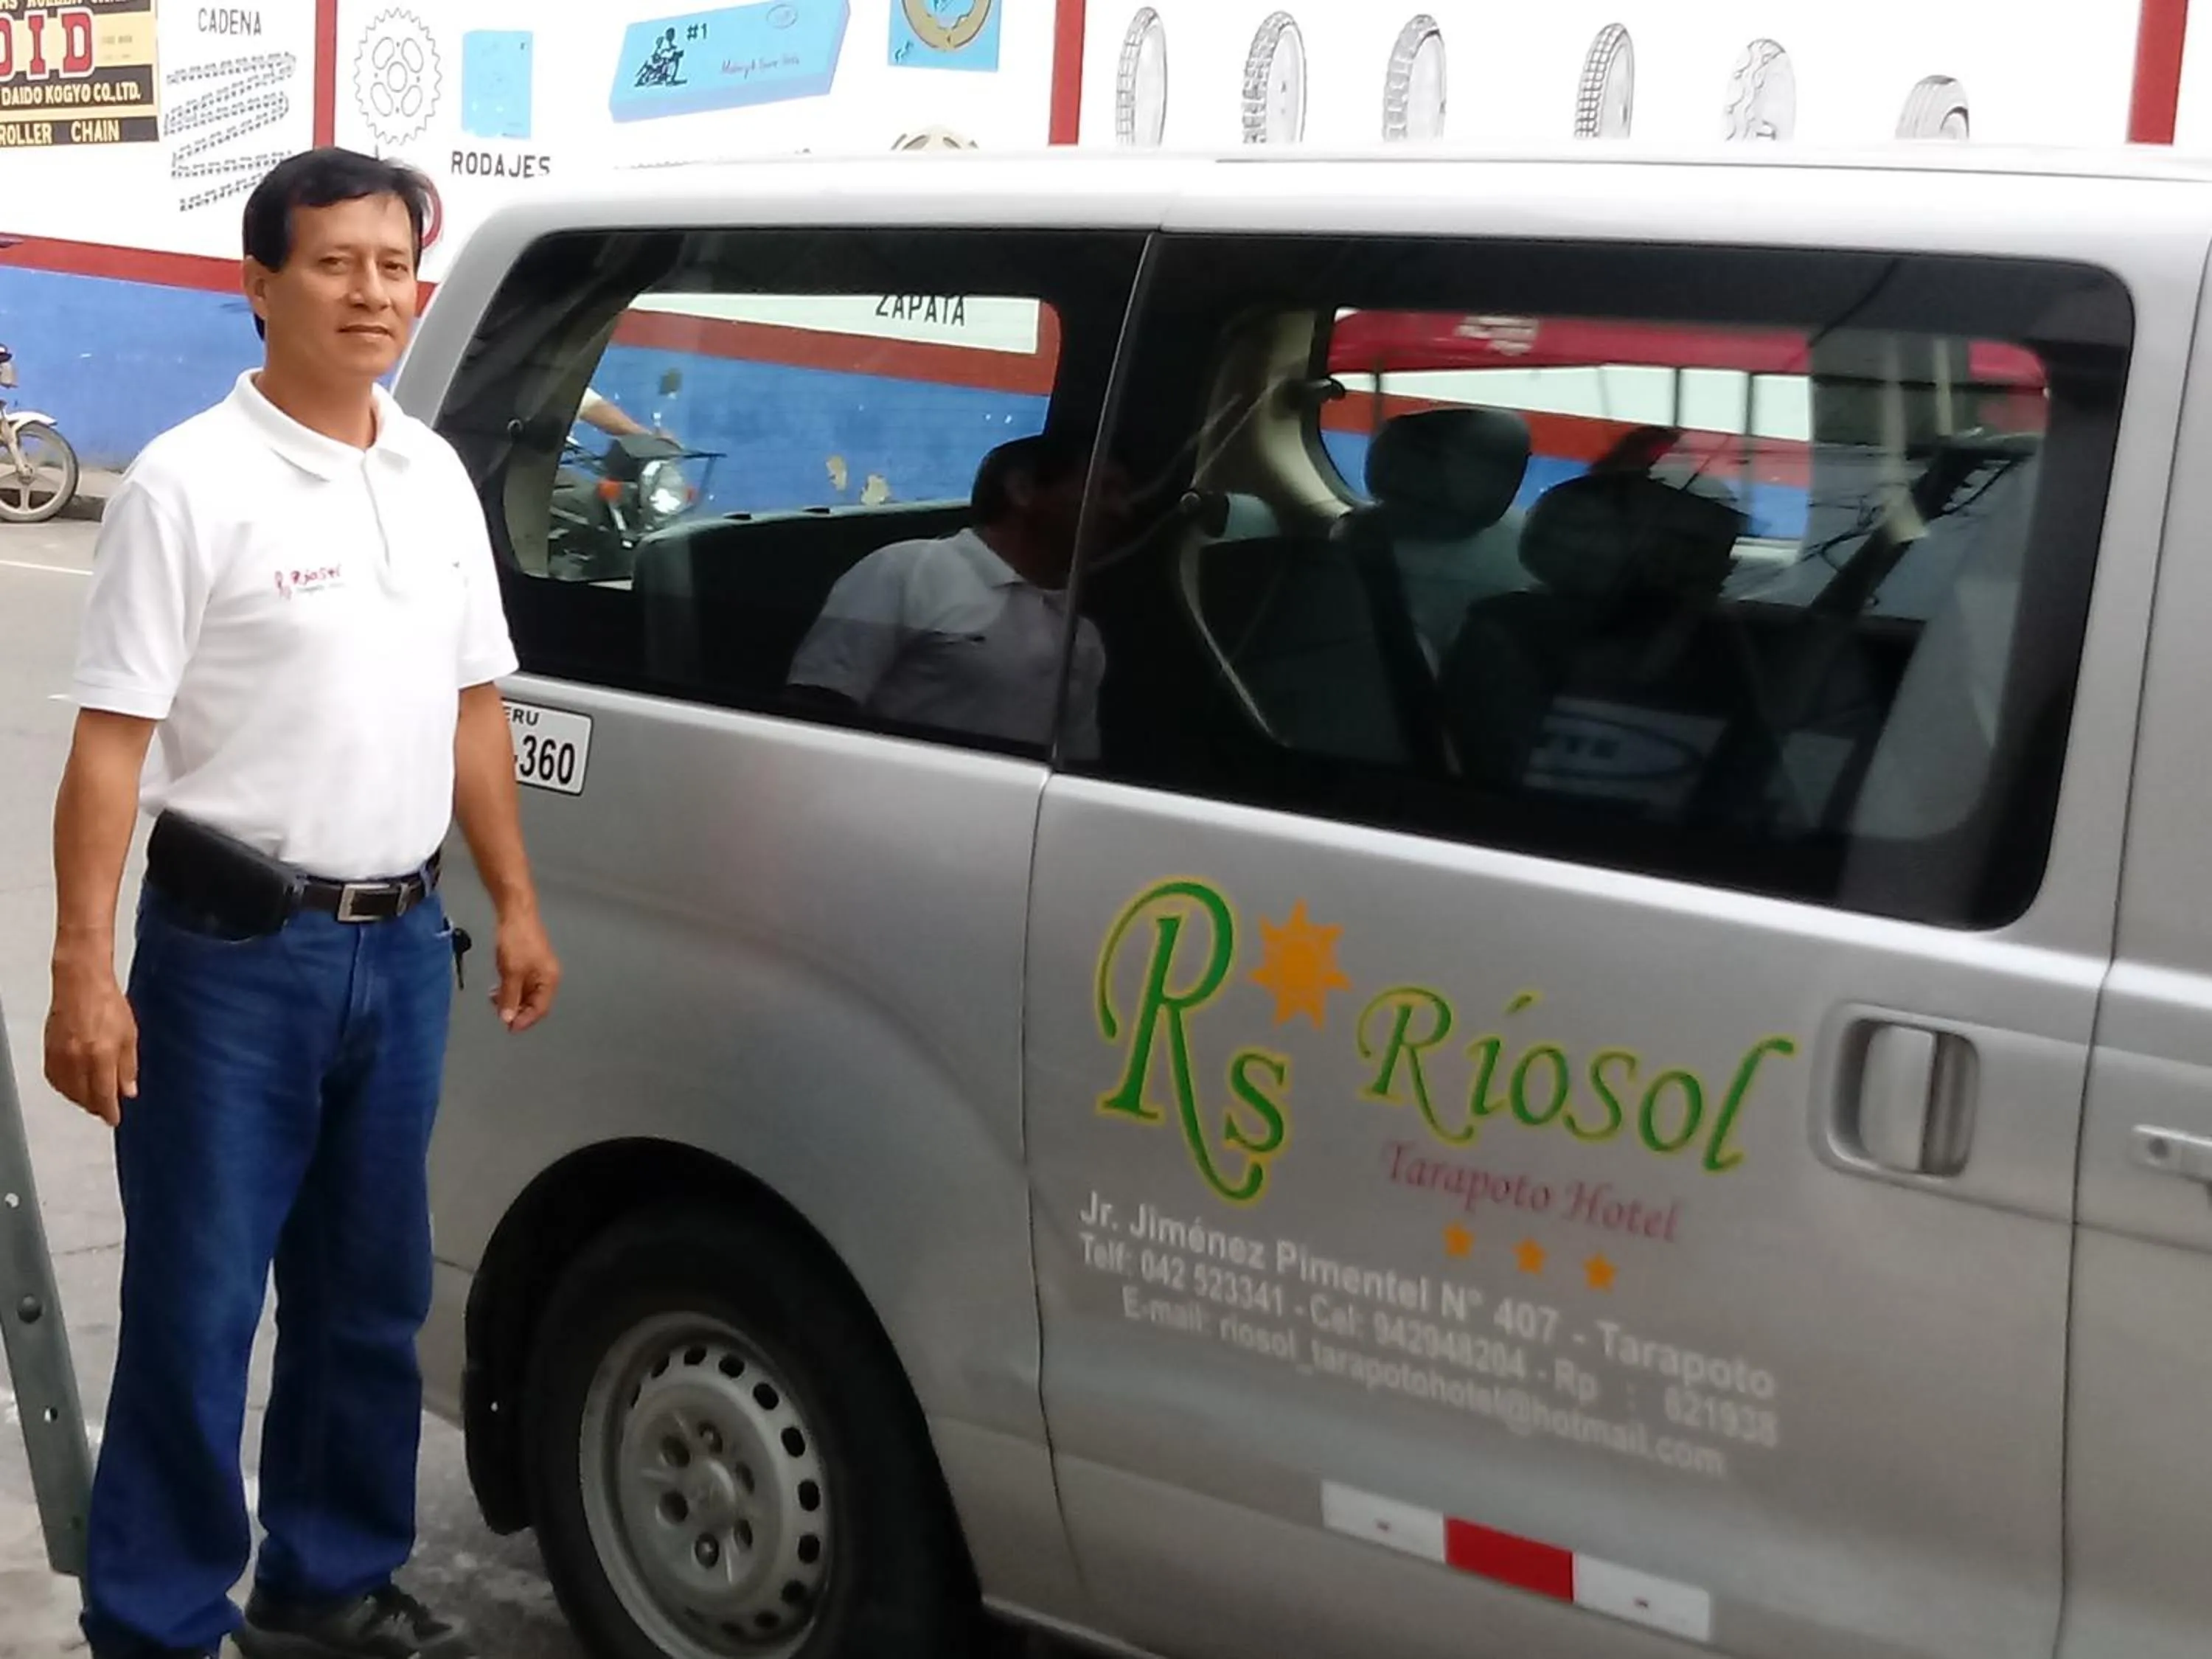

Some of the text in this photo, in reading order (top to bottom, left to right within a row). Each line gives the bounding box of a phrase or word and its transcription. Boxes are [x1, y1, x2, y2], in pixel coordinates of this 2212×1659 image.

[198, 7, 262, 35] CADENA
[1, 86, 42, 105] DAIDO
[45, 83, 91, 104] KOGYO
[71, 119, 120, 142] CHAIN
[451, 150, 551, 178] RODAJES
[875, 294, 964, 326] ZAPATA
[1357, 985, 1798, 1172] Ríosol
[1381, 1139, 1683, 1243] Tarapoto Hotel
[1079, 1190, 1119, 1231] Jr.
[1129, 1203, 1266, 1270] Jiménez
[1276, 1239, 1430, 1313] Pimentel
[1493, 1296, 1559, 1345] 407
[1594, 1318, 1775, 1401] Tarapoto
[1141, 1248, 1186, 1290] 042
[1193, 1262, 1283, 1318] 523341
